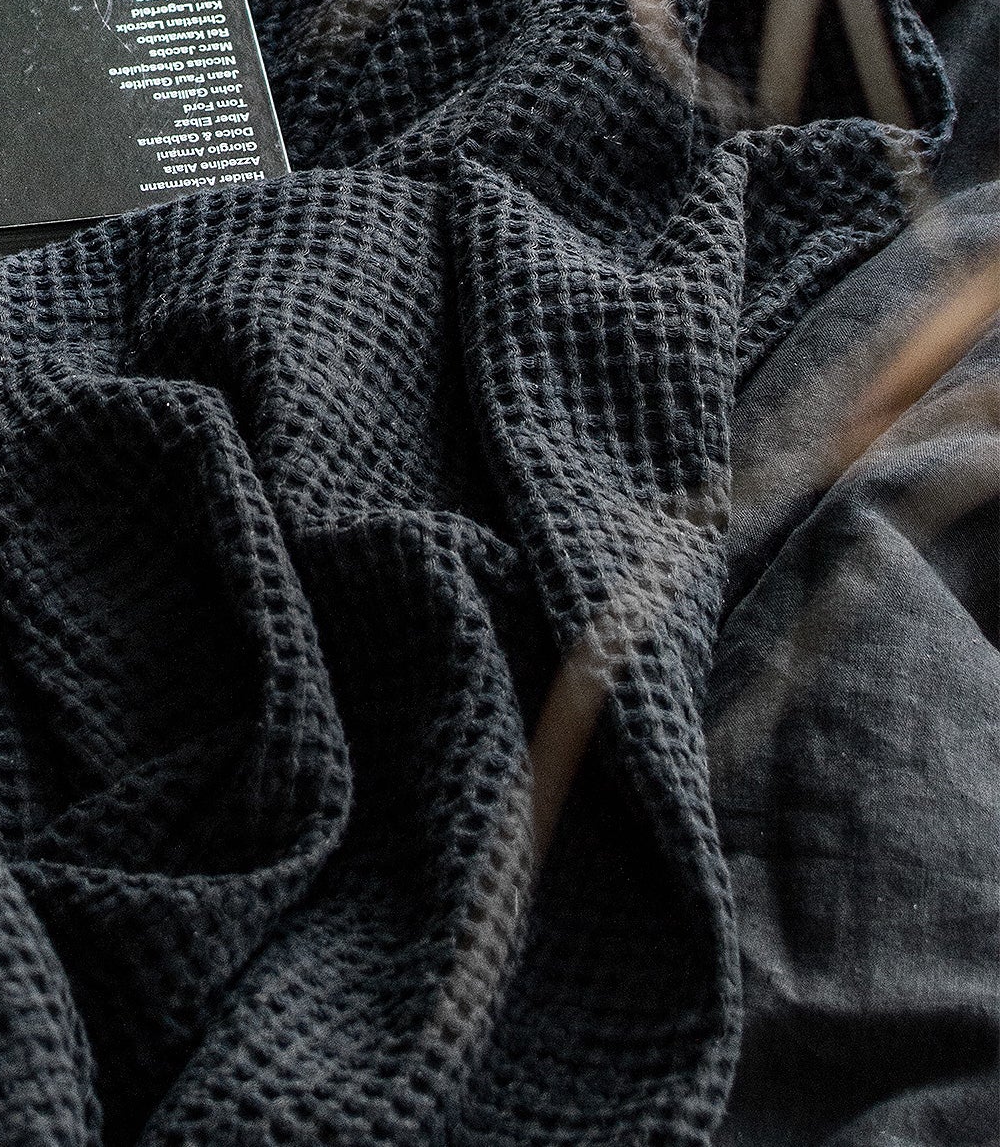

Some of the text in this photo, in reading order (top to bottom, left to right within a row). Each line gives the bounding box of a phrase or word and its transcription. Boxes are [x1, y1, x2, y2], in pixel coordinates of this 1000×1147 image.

[130, 0, 224, 19] Karl Lagerfeld
[115, 13, 227, 34] Christian Lacroix
[136, 27, 230, 45] Rei Kawakubo
[148, 41, 234, 59] Marc Jacobs
[108, 55, 237, 77] Nicolas Ghesquière
[119, 69, 240, 91] Jean Paul Gaultier
[152, 83, 243, 101] John Galliano
[182, 98, 249, 114] Tom Ford
[173, 111, 250, 128] Alber Elbaz
[136, 126, 255, 147] Dolce & Gabbana
[156, 141, 258, 161] Giorgio Armani
[162, 155, 261, 175] Azzedine Alaïa
[139, 170, 266, 192] Haider Ackermann
